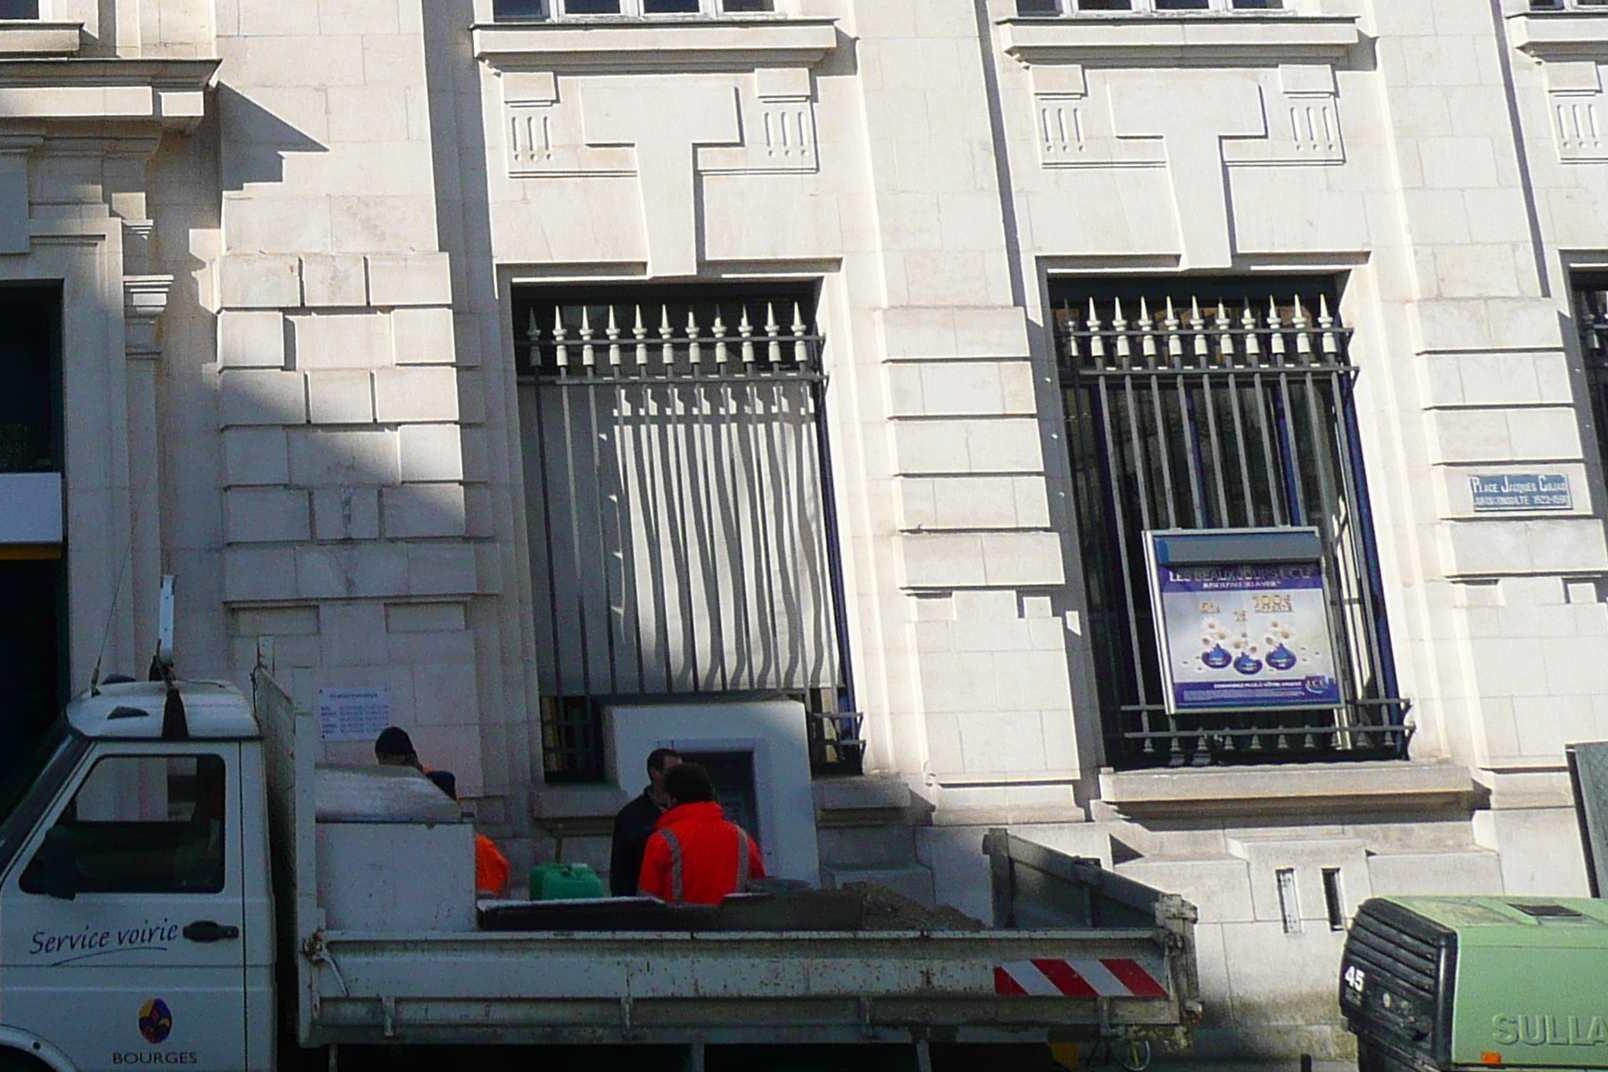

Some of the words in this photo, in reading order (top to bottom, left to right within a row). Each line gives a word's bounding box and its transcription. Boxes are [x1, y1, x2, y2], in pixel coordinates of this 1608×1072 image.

[29, 924, 110, 954] Service
[117, 918, 179, 945] voirie
[1344, 965, 1365, 991] 45
[112, 1051, 198, 1065] BOURGES
